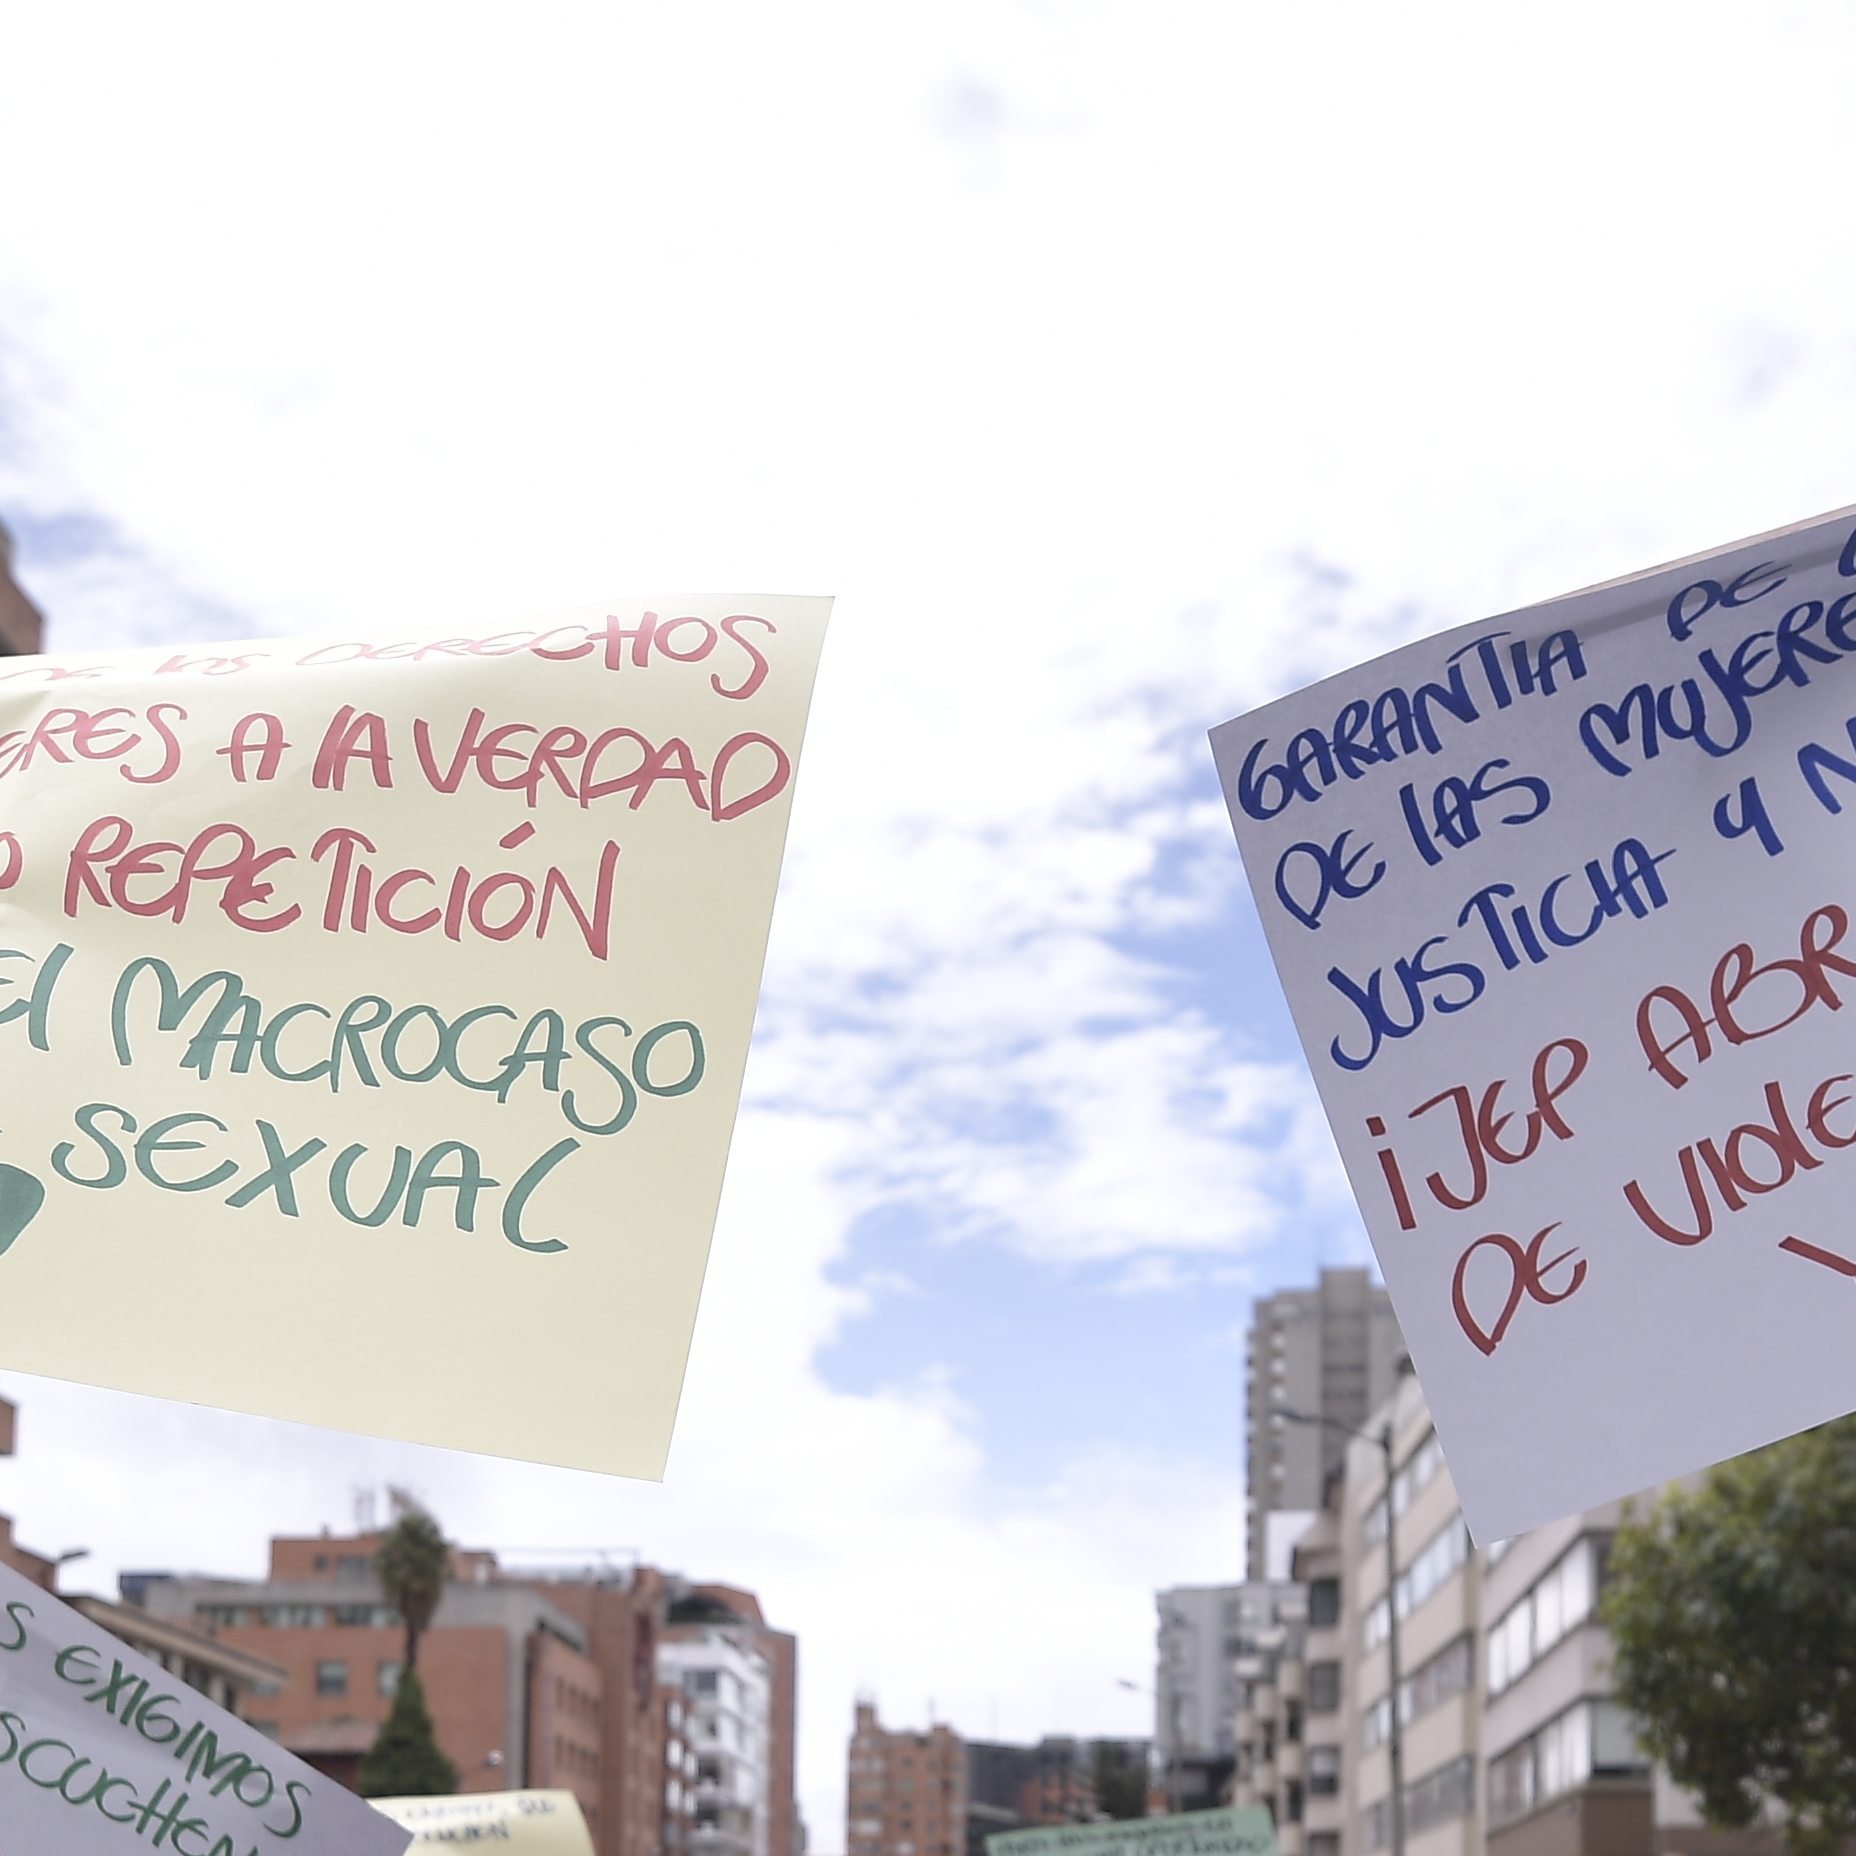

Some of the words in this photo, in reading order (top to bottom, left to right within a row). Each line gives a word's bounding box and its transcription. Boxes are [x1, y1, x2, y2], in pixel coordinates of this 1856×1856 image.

[1666, 556, 1756, 641] DE
[215, 709, 294, 784] A
[410, 709, 792, 822] VERDAD
[63, 821, 619, 960] REPETICIÓN
[1275, 831, 1385, 931] DE
[1328, 838, 1675, 1072] JUSTICIA
[112, 952, 706, 1138] MACROCASO
[1449, 1220, 1588, 1356] DE
[52, 1644, 317, 1843] EXIGIMOS
